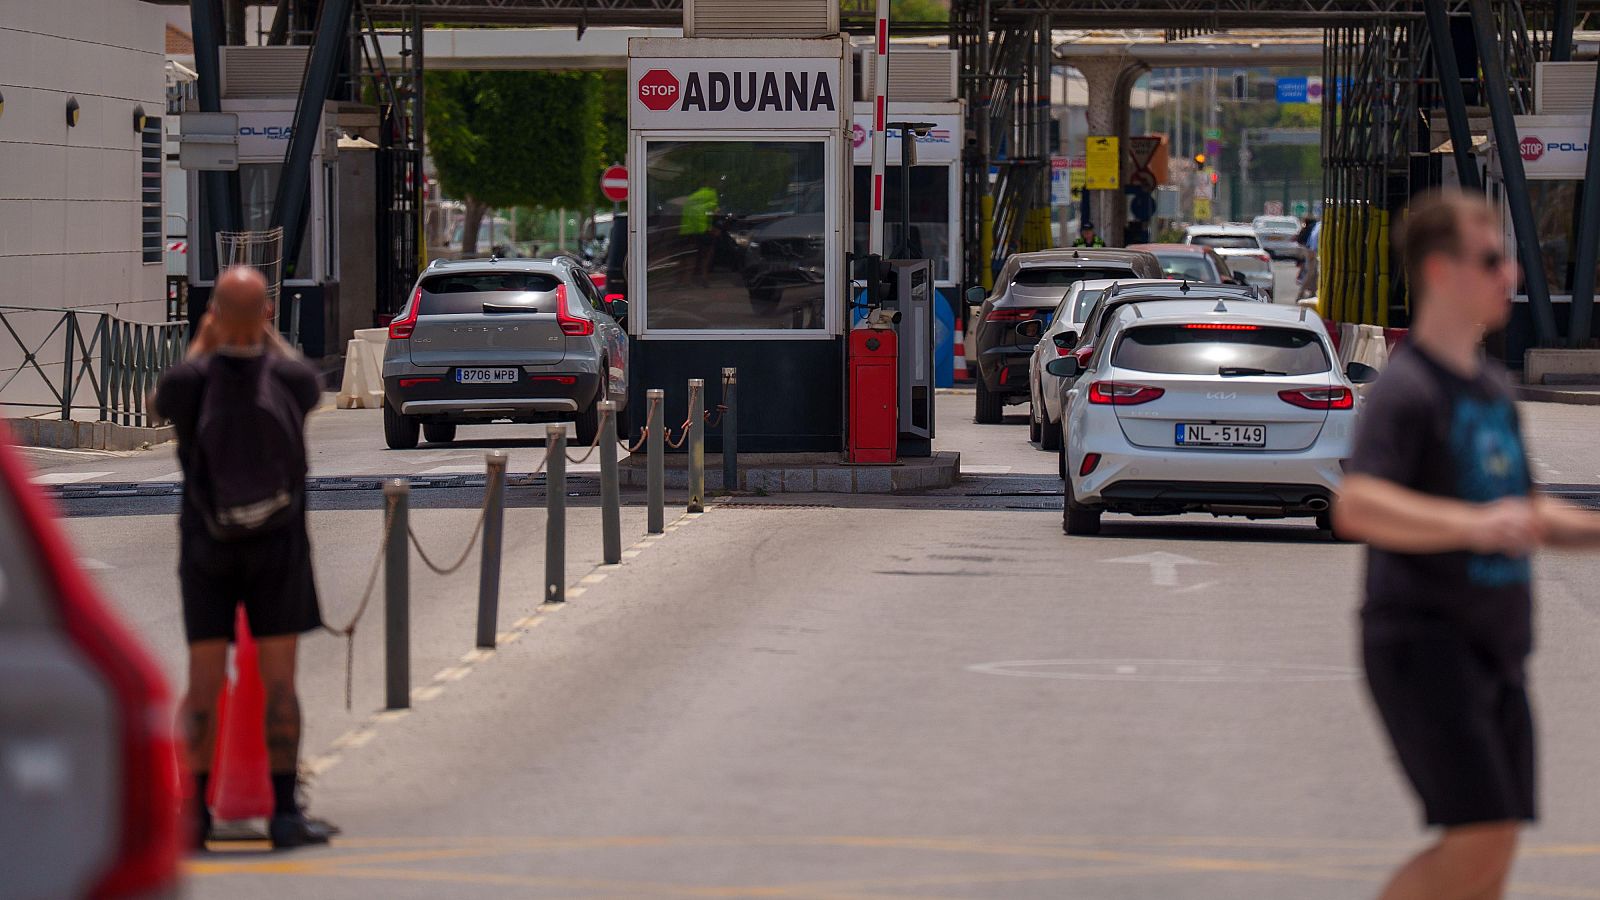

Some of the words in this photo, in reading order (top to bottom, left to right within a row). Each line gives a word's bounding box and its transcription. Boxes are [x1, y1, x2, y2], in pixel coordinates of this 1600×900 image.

[641, 85, 676, 96] STOP
[680, 71, 836, 112] ADUANA
[239, 126, 293, 136] OLICIA
[1519, 143, 1542, 155] STOP
[1547, 142, 1588, 151] POLI
[463, 368, 491, 381] 8706
[494, 367, 515, 380] MPB
[1206, 391, 1237, 400] KIA
